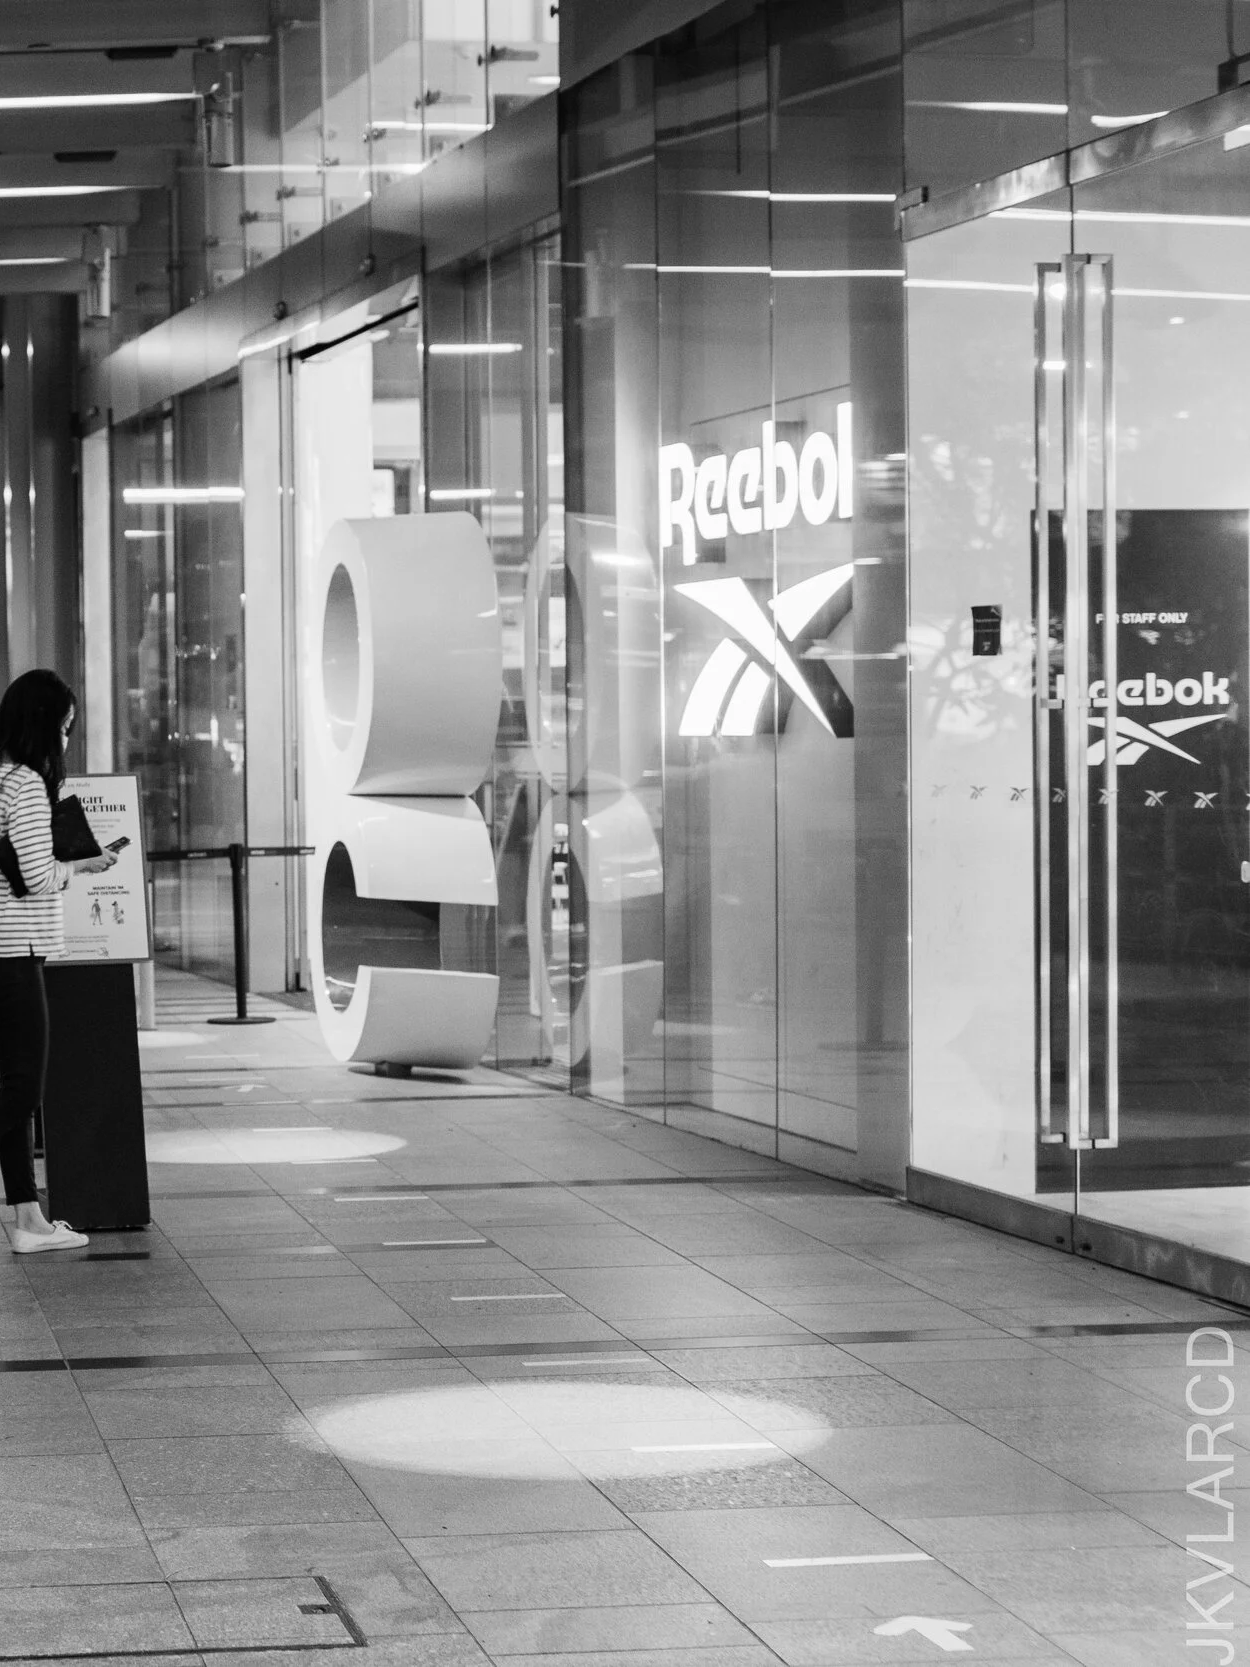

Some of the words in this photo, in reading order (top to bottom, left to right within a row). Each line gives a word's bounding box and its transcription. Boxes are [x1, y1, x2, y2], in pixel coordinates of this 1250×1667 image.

[1122, 612, 1156, 624] STAFF
[1158, 612, 1189, 624] ONLY
[83, 804, 126, 812] GETHER
